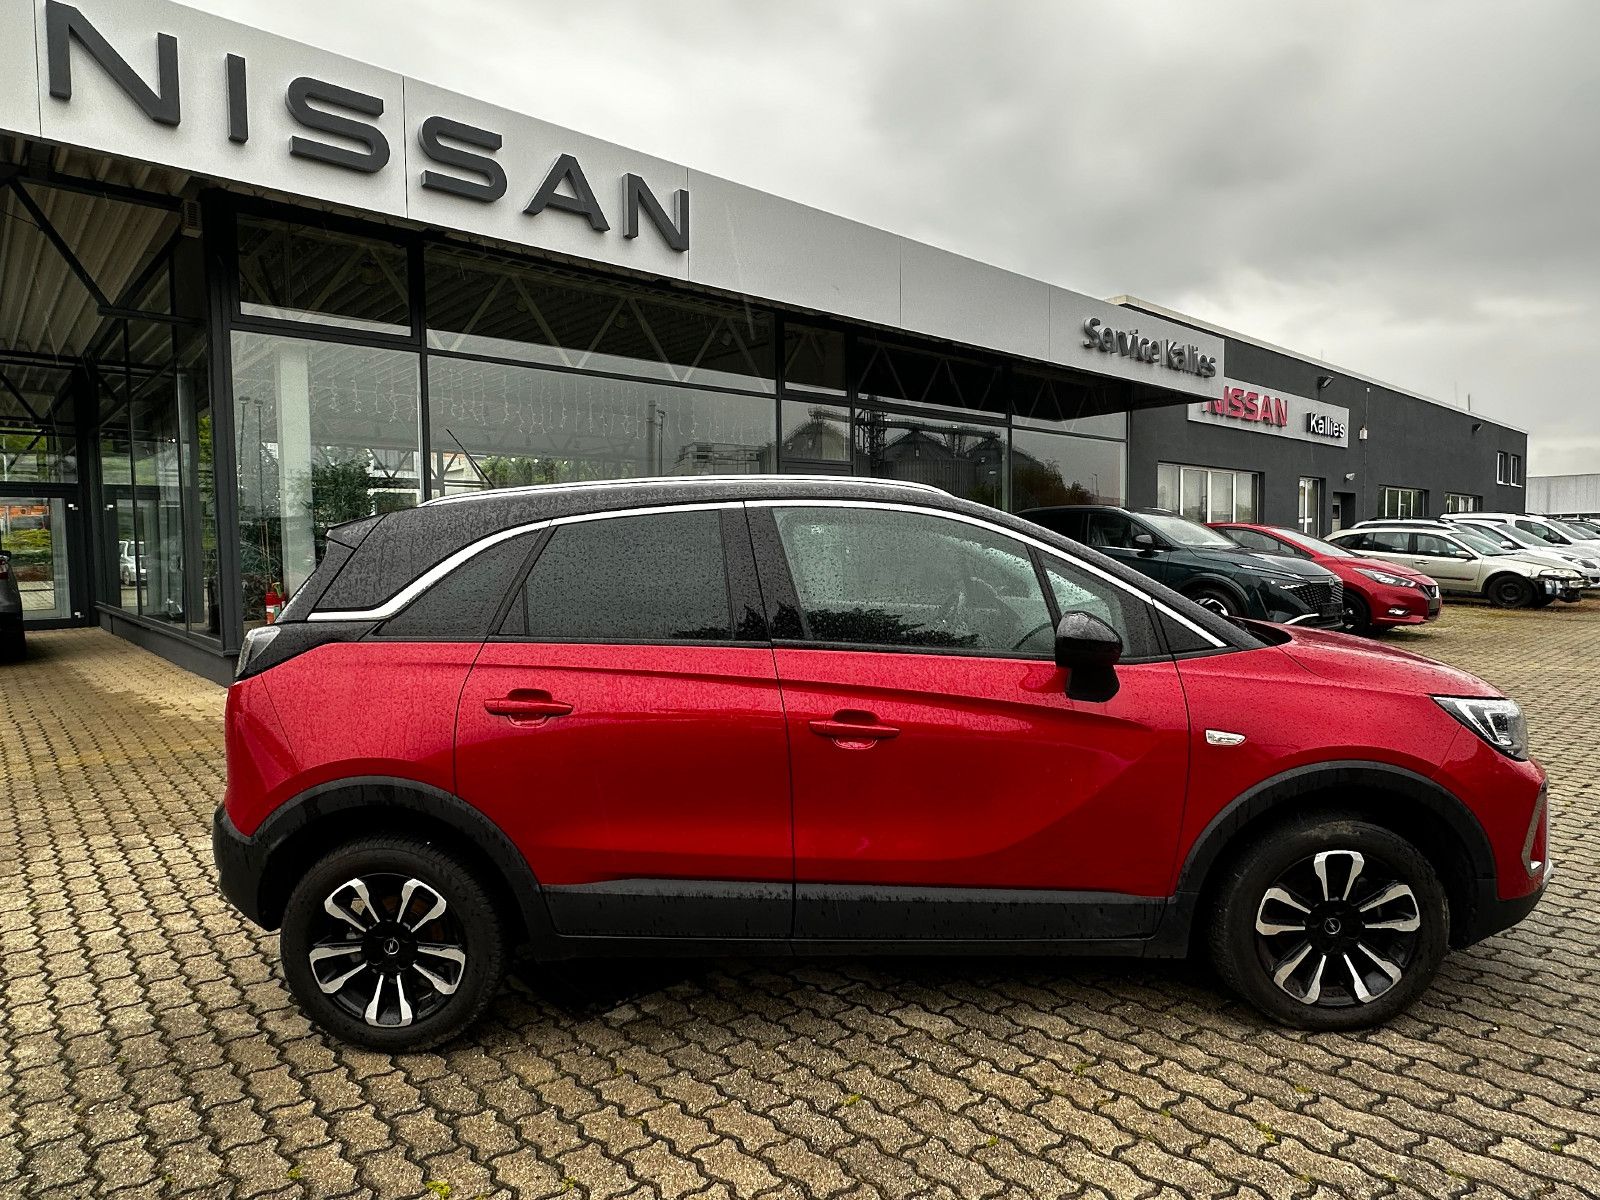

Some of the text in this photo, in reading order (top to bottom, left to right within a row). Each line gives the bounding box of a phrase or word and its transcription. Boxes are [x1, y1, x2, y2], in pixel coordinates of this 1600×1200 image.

[47, 0, 690, 252] NISSAN
[1082, 317, 1217, 378] Service Kallies
[1307, 412, 1345, 438] Kallies
